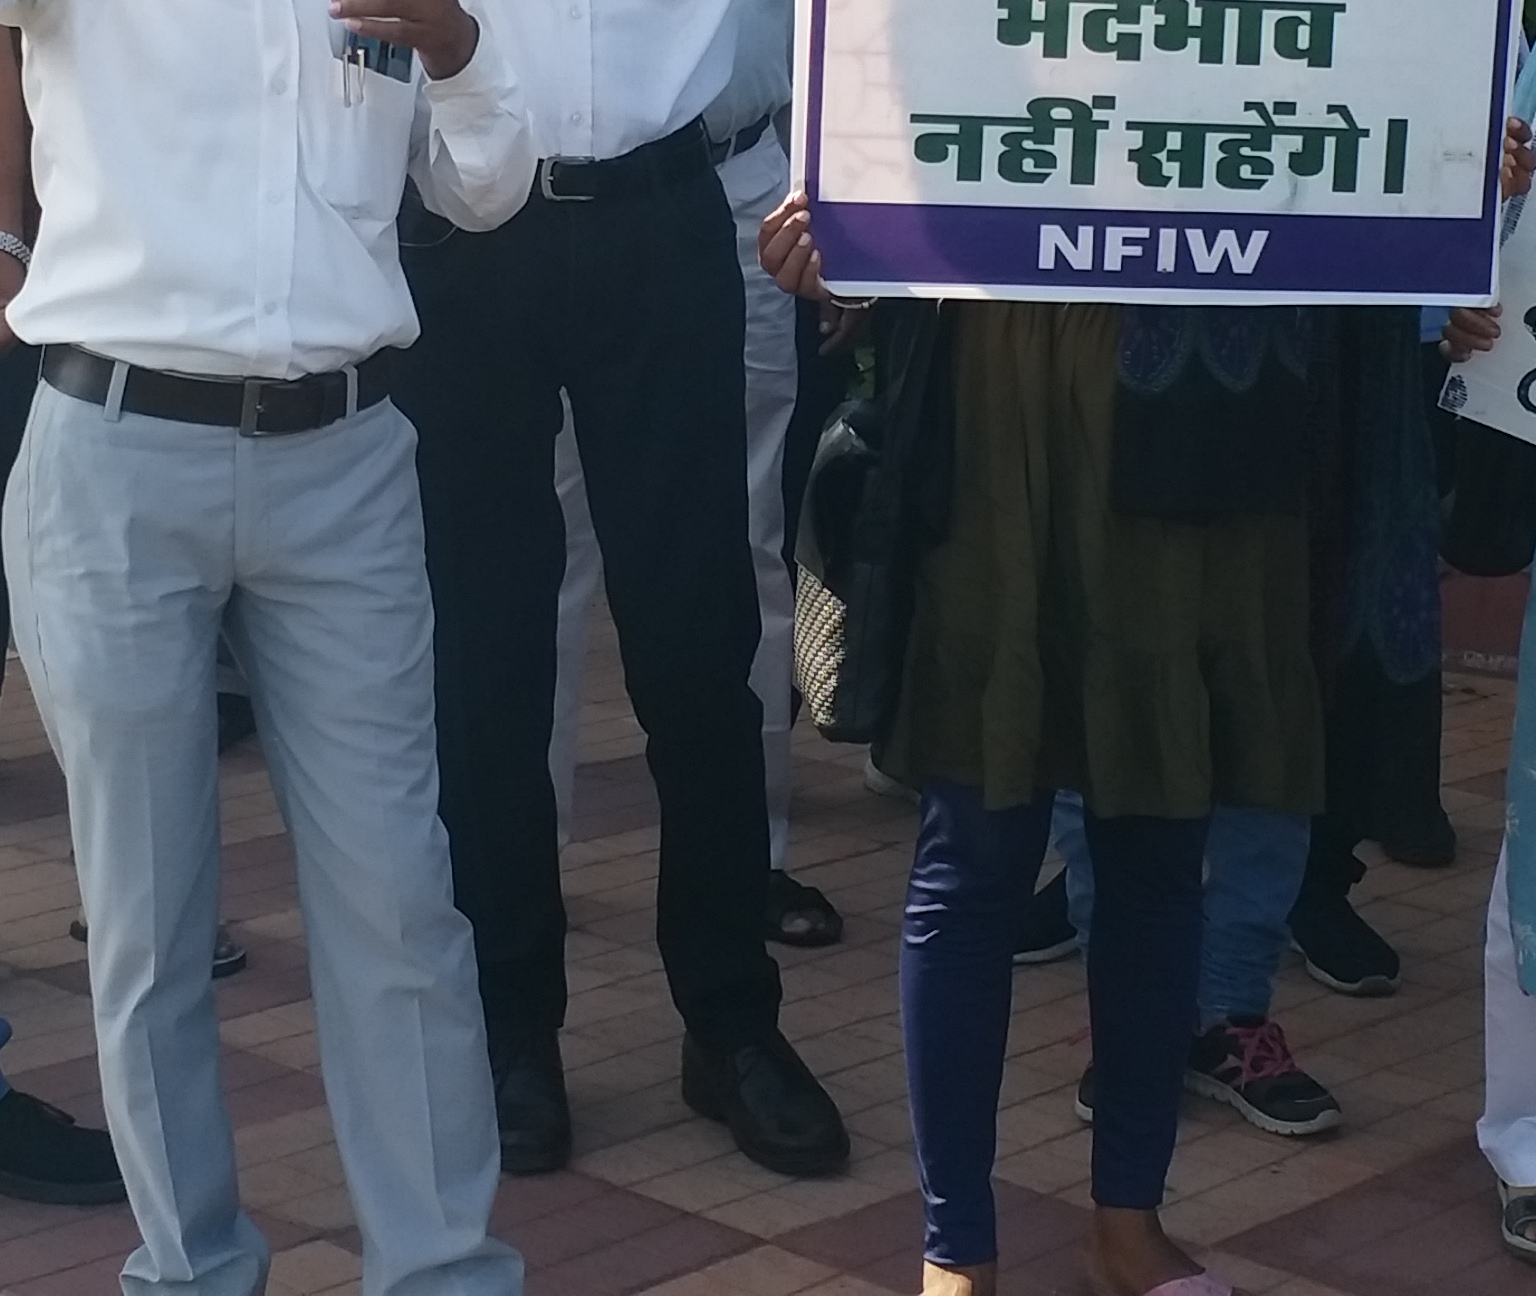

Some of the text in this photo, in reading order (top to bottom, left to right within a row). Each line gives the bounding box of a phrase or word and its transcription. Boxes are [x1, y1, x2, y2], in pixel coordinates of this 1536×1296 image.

[910, 95, 1408, 194] नहीं सहेंगे।
[1038, 224, 1269, 275] NFIW
